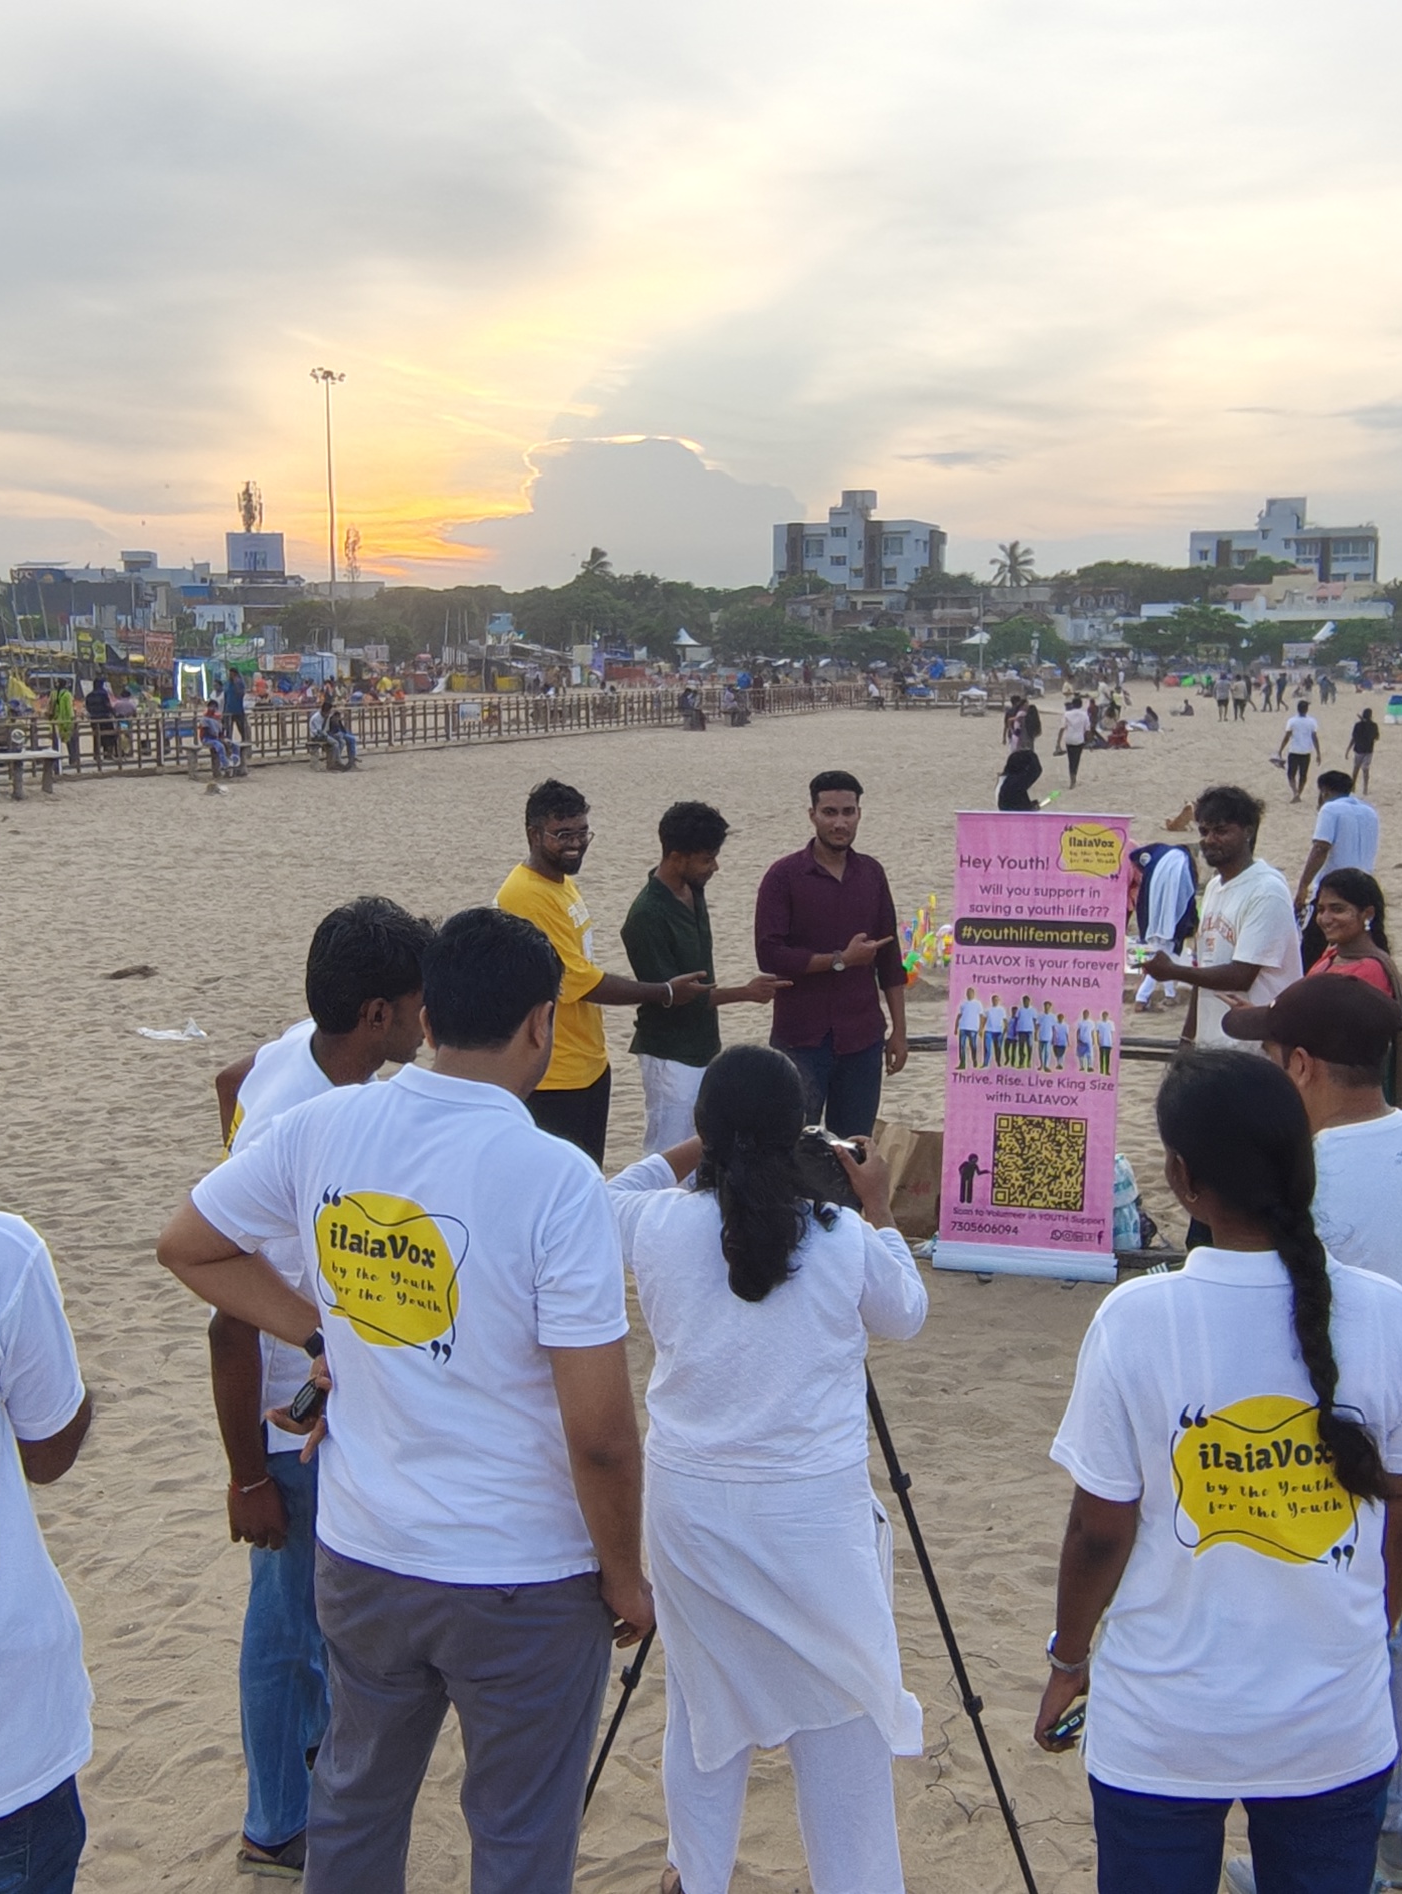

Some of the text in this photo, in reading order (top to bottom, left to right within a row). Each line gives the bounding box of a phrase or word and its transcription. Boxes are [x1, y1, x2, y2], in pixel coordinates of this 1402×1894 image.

[959, 854, 1050, 871] Hey Youth!
[979, 884, 1101, 901] Will you support in
[969, 902, 1110, 917] saving a youth life???
[961, 925, 1110, 945] #youthlifematters
[955, 953, 1120, 972] ILAIAVOX is your forever
[972, 973, 1101, 988] trustworthy NANBA
[951, 1072, 1115, 1092] Thrive. Rise. Live King Size
[985, 1091, 1079, 1106] with ILAIAVOX
[953, 1207, 973, 1215] Scan
[986, 1210, 1026, 1219] Volunteer
[1038, 1213, 1069, 1221] YOUTH
[1071, 1215, 1106, 1225] Support
[951, 1221, 1019, 1235] 7305606094
[331, 1262, 437, 1293] by the Youth
[359, 1288, 386, 1303] the
[396, 1291, 443, 1313] Youth
[1205, 1477, 1336, 1498] by the Youth
[1208, 1497, 1344, 1519] for the Youth
